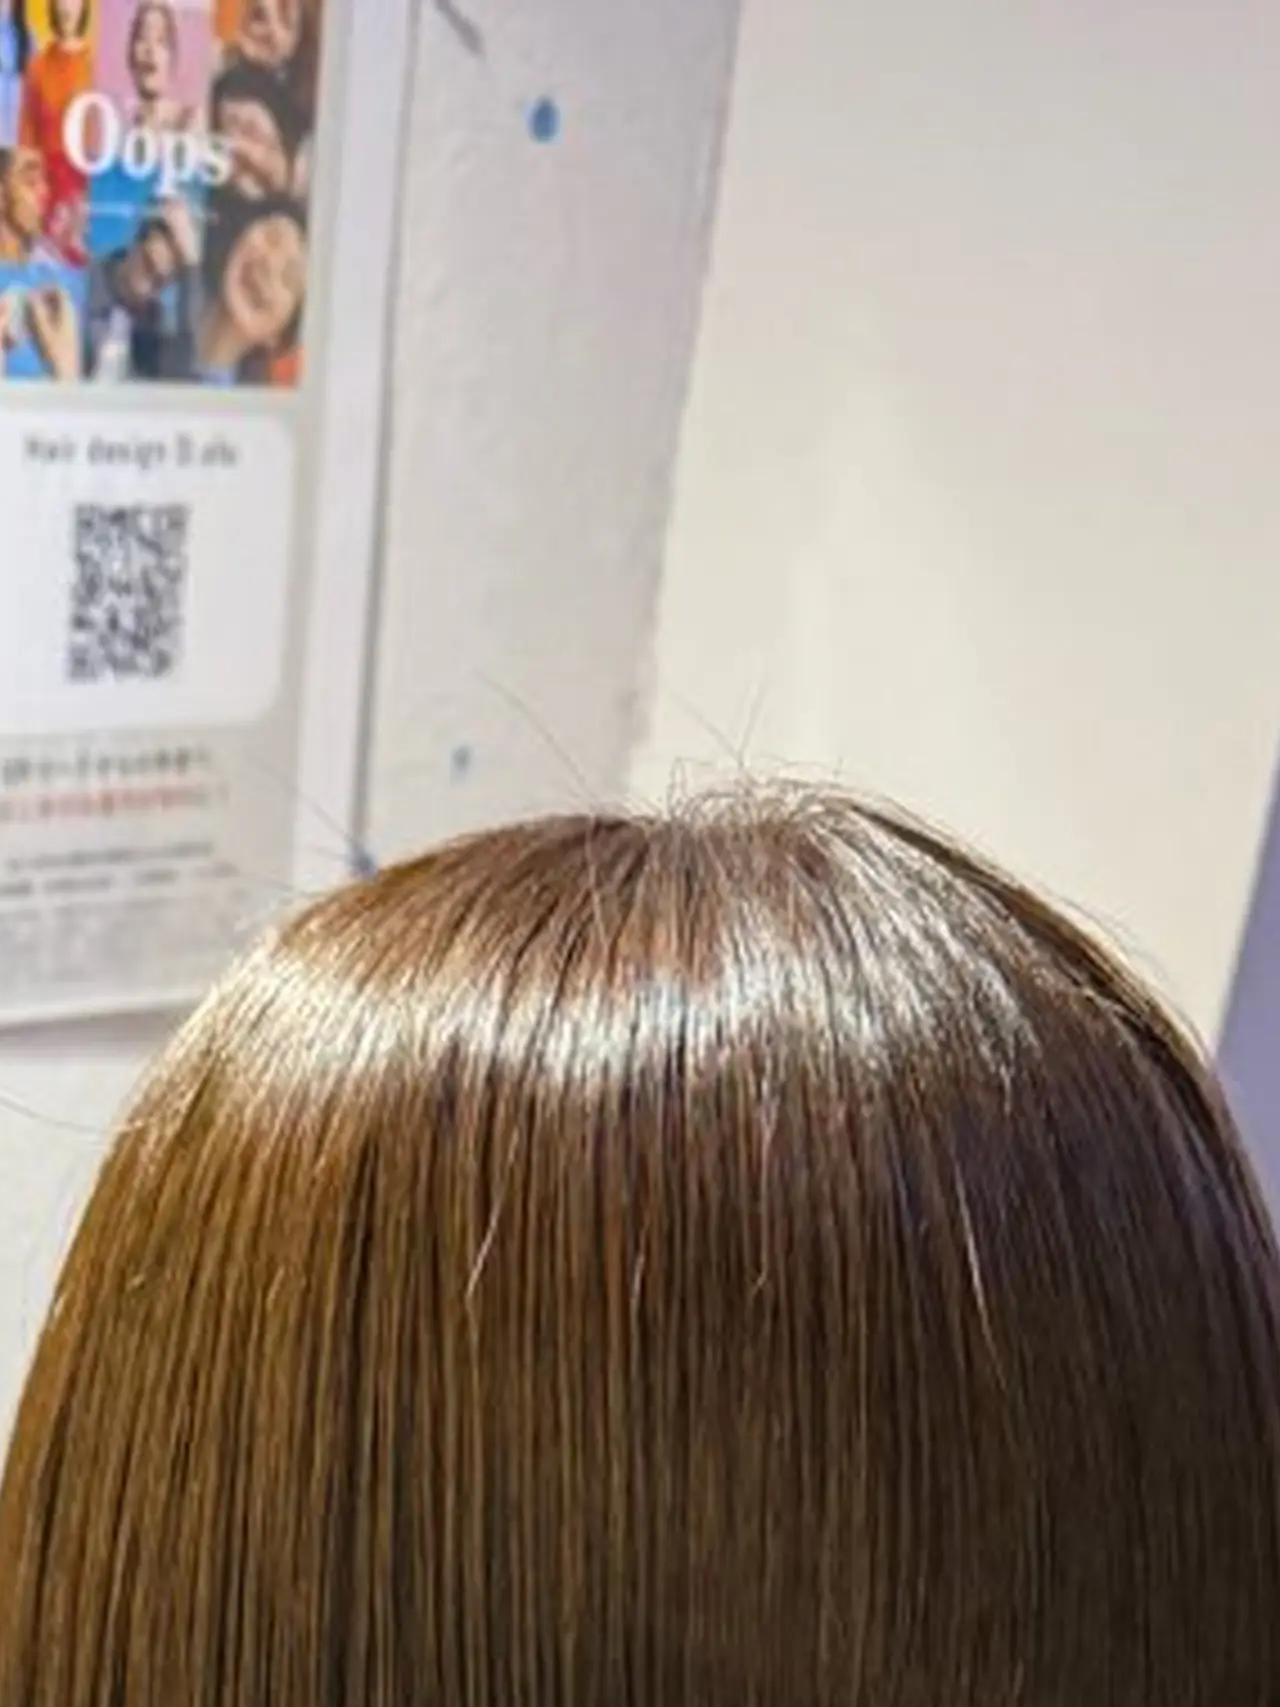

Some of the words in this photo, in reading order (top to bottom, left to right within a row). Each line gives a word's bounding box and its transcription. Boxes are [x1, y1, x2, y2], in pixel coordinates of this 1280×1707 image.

[62, 91, 233, 197] Oops
[23, 433, 76, 464] Hair
[85, 434, 166, 472] design
